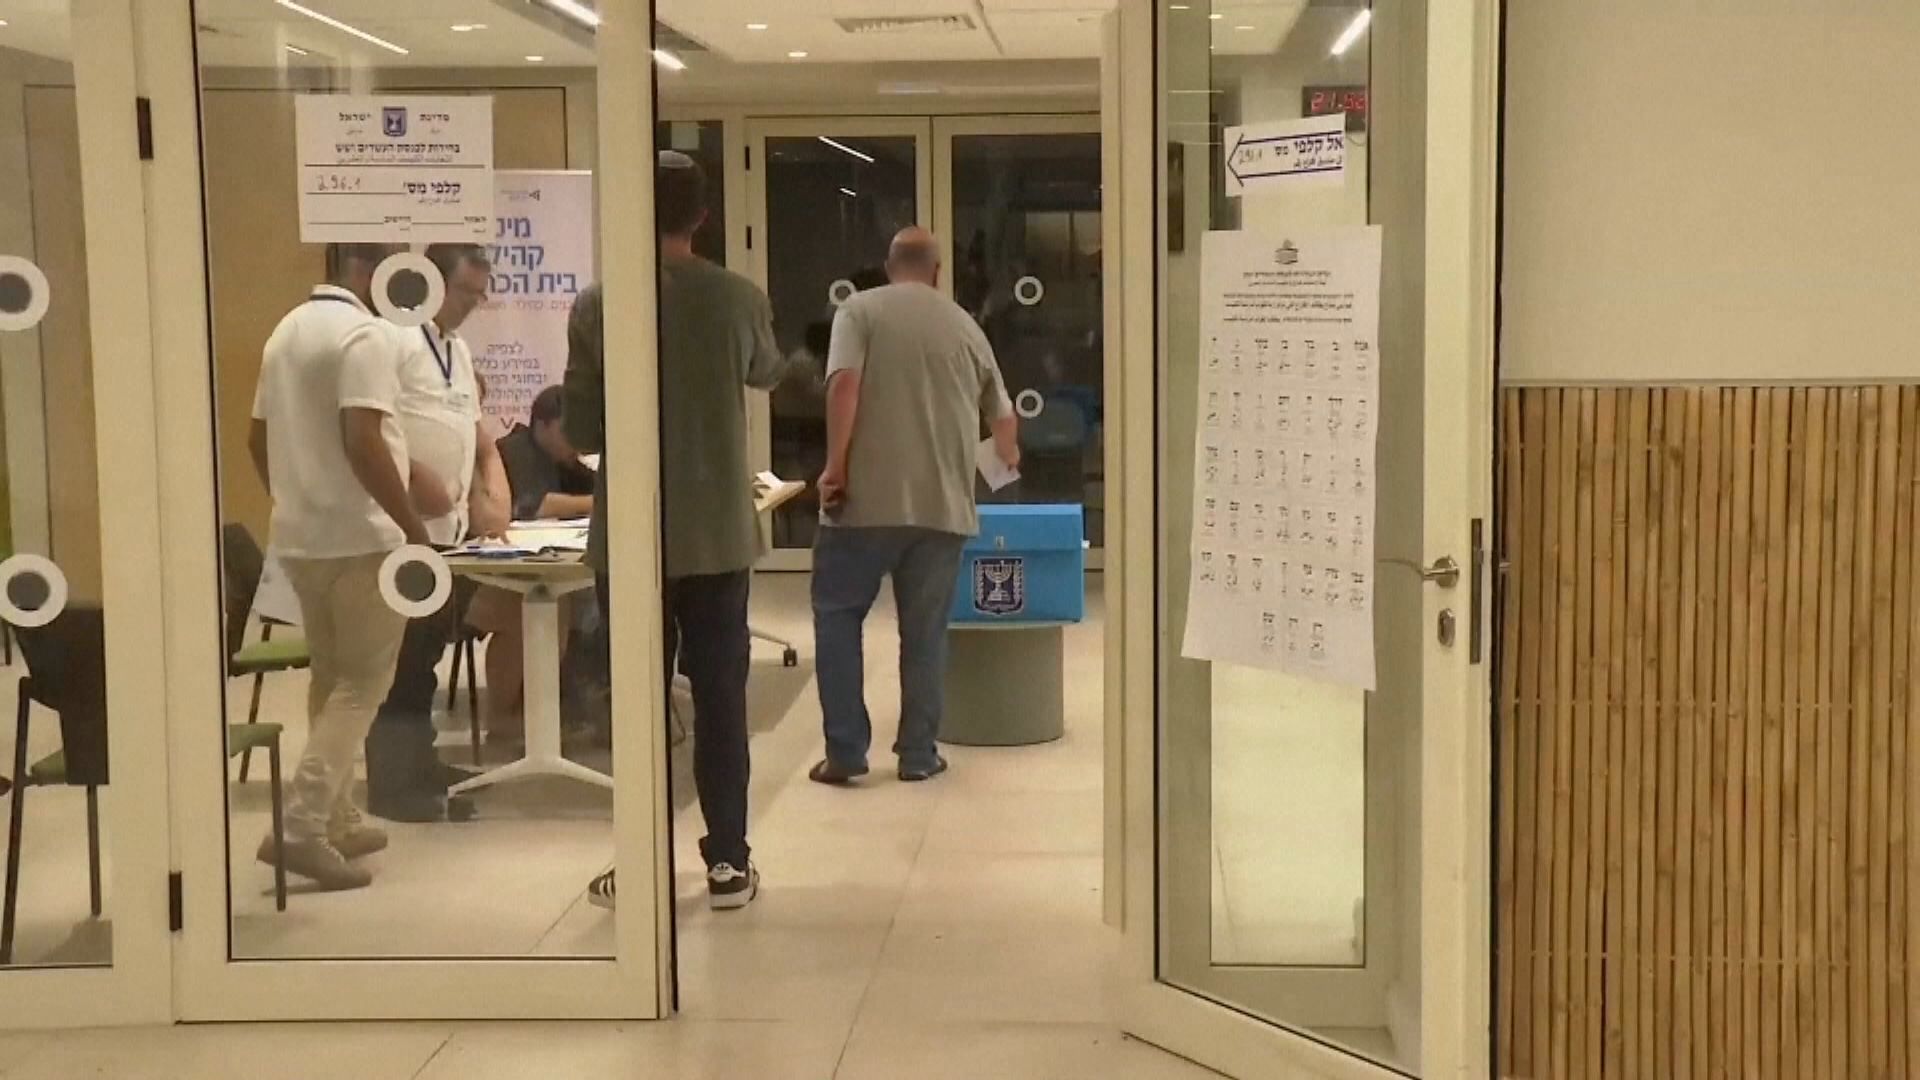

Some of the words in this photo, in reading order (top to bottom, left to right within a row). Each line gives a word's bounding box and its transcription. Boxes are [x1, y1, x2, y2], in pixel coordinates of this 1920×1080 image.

[339, 112, 371, 121] ישראל
[1293, 138, 1324, 155] קלפי
[1326, 134, 1344, 151] אל
[430, 179, 461, 196] קלפי
[495, 216, 532, 238] מינ
[486, 245, 545, 271] קהיל
[487, 273, 529, 293] הכר
[536, 273, 577, 293] בית
